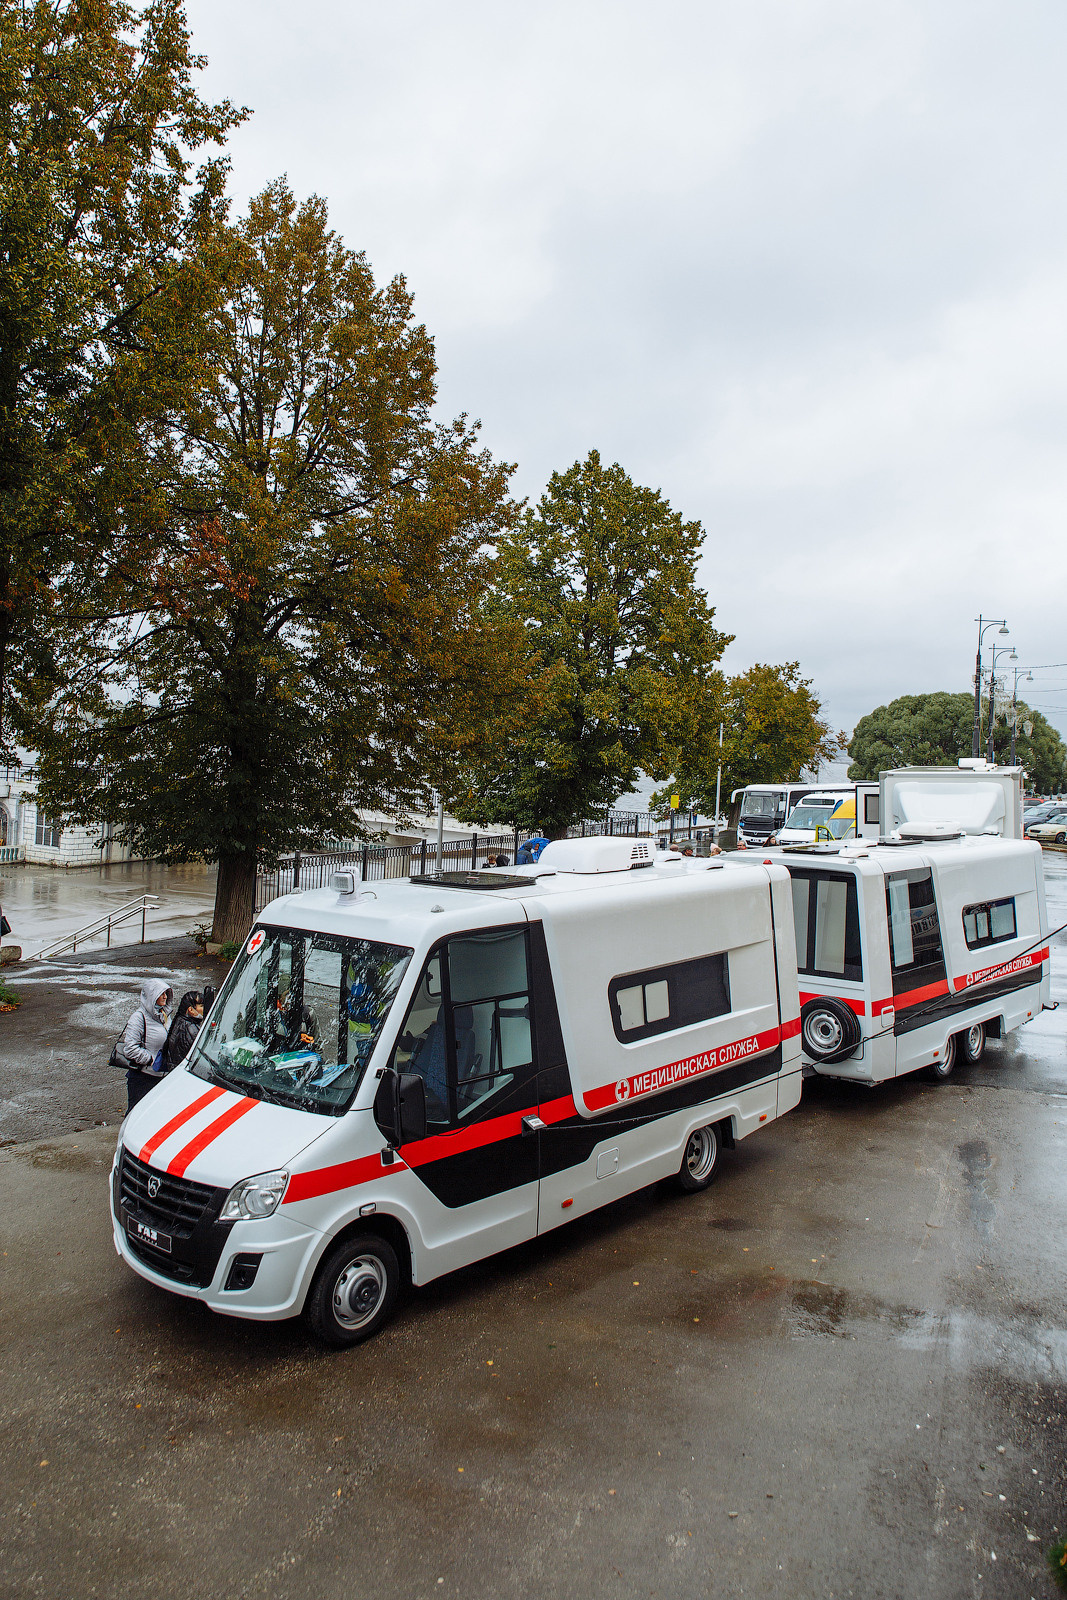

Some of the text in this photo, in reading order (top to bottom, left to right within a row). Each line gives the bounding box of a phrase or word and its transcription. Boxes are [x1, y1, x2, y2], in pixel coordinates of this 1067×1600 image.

[1012, 956, 1033, 970] СЛУЖБА
[633, 1037, 759, 1093] МЕДИЦИНСКАЯ СЛУЖБА
[137, 1223, 158, 1241] ГАЗ
